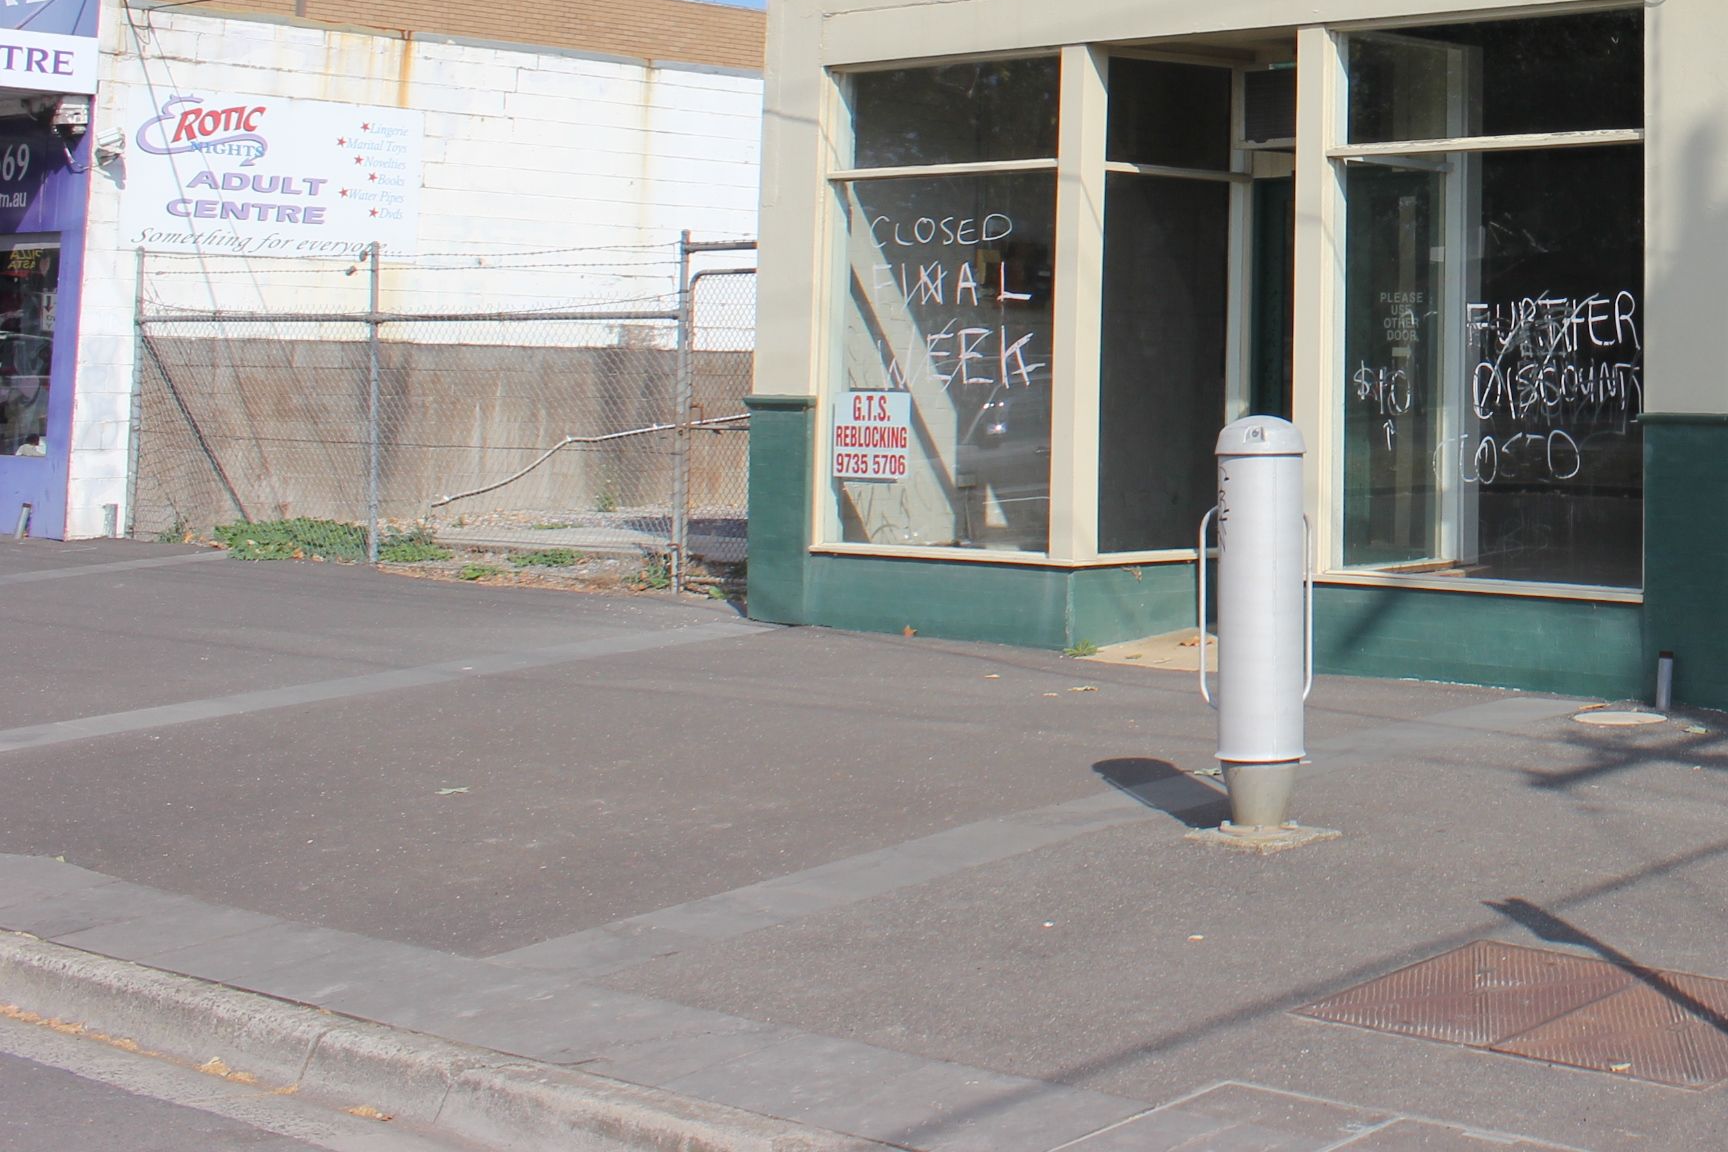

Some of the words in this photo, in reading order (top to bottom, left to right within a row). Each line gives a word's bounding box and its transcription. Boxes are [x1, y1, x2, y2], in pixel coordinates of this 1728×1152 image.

[191, 141, 265, 158] NIGHTS
[346, 138, 382, 150] Marital
[385, 143, 407, 154] Toys
[363, 156, 406, 169] Novelties
[186, 170, 328, 196] ADULT
[377, 175, 404, 186] Books
[348, 188, 377, 201] Water
[379, 191, 404, 205] Pipes
[166, 198, 328, 225] CENTRE
[870, 213, 1013, 249] CLOSED
[131, 227, 252, 251] Something
[248, 233, 293, 253] for
[1380, 292, 1424, 303] PLEASE
[1383, 318, 1419, 329] OTHER
[1387, 330, 1419, 342] DOOR
[853, 395, 891, 422] G.T.S.
[836, 425, 908, 449] REBLOCKING
[836, 453, 868, 474] 9735
[872, 454, 906, 475] 5706
